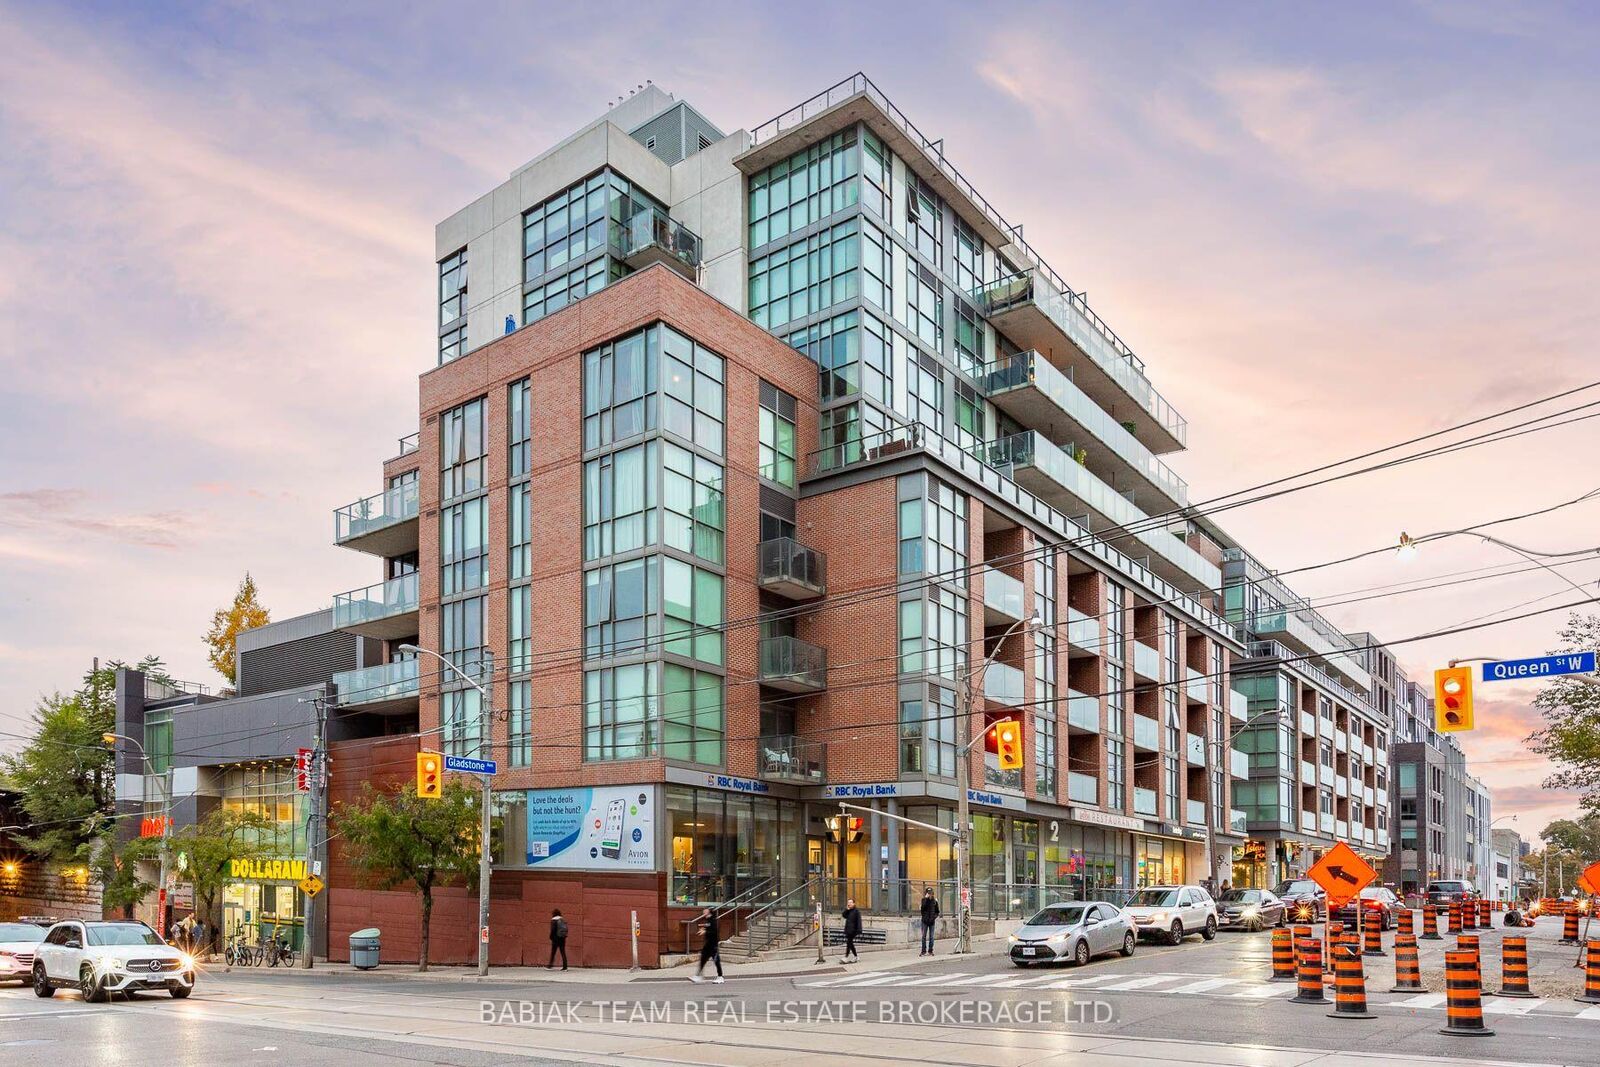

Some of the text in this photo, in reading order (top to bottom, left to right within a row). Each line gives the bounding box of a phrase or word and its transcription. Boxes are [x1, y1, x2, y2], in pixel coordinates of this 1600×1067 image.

[1494, 656, 1582, 678] Queen St W
[448, 757, 485, 770] Gladstone
[717, 776, 768, 792] RBC Royal Bank
[835, 784, 896, 797] RBC Royal Bank
[532, 794, 574, 804] Love the deals
[967, 790, 1003, 805] BC Royal Bank
[532, 807, 543, 815] but
[554, 806, 564, 815] the
[564, 805, 582, 815] hunt?
[1050, 820, 1059, 842] 2
[231, 858, 308, 880] DOLLARAM
